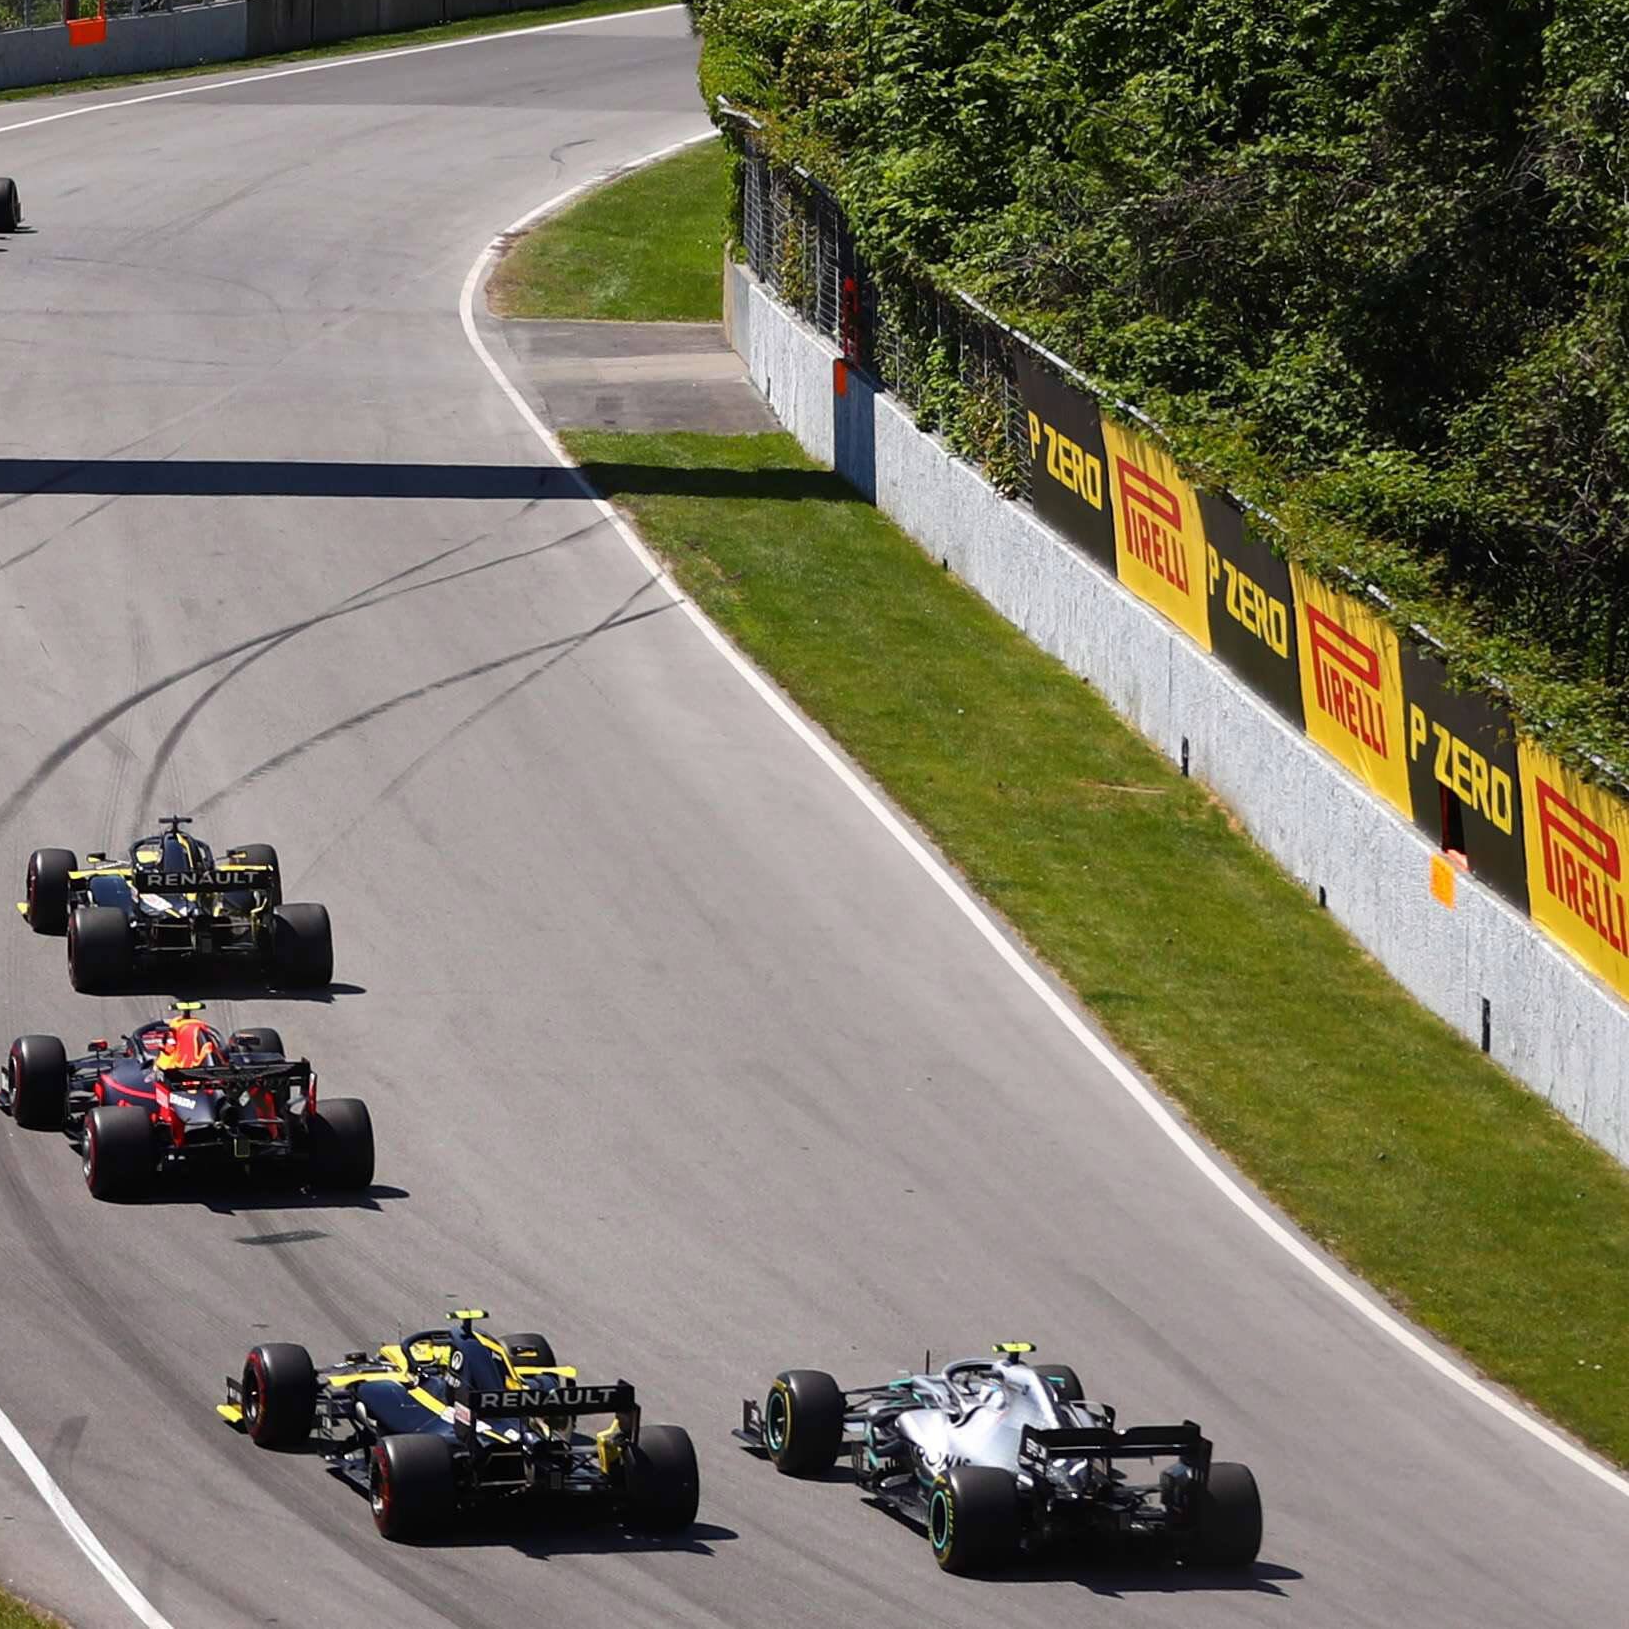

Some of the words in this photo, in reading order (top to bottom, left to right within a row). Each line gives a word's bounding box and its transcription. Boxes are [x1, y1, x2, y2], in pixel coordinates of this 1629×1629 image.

[1027, 409, 1041, 460] P
[1043, 422, 1102, 511] ZERO
[1116, 454, 1189, 596] PIRELLI
[1206, 541, 1220, 595] P
[1222, 557, 1289, 659] ZERO
[1306, 602, 1388, 760] PIRELLI
[1410, 701, 1428, 762] P
[1432, 721, 1513, 836] ZERO
[147, 871, 259, 887] RENAULT
[1535, 776, 1629, 958] PIRELLI
[480, 1387, 617, 1409] RENAULT
